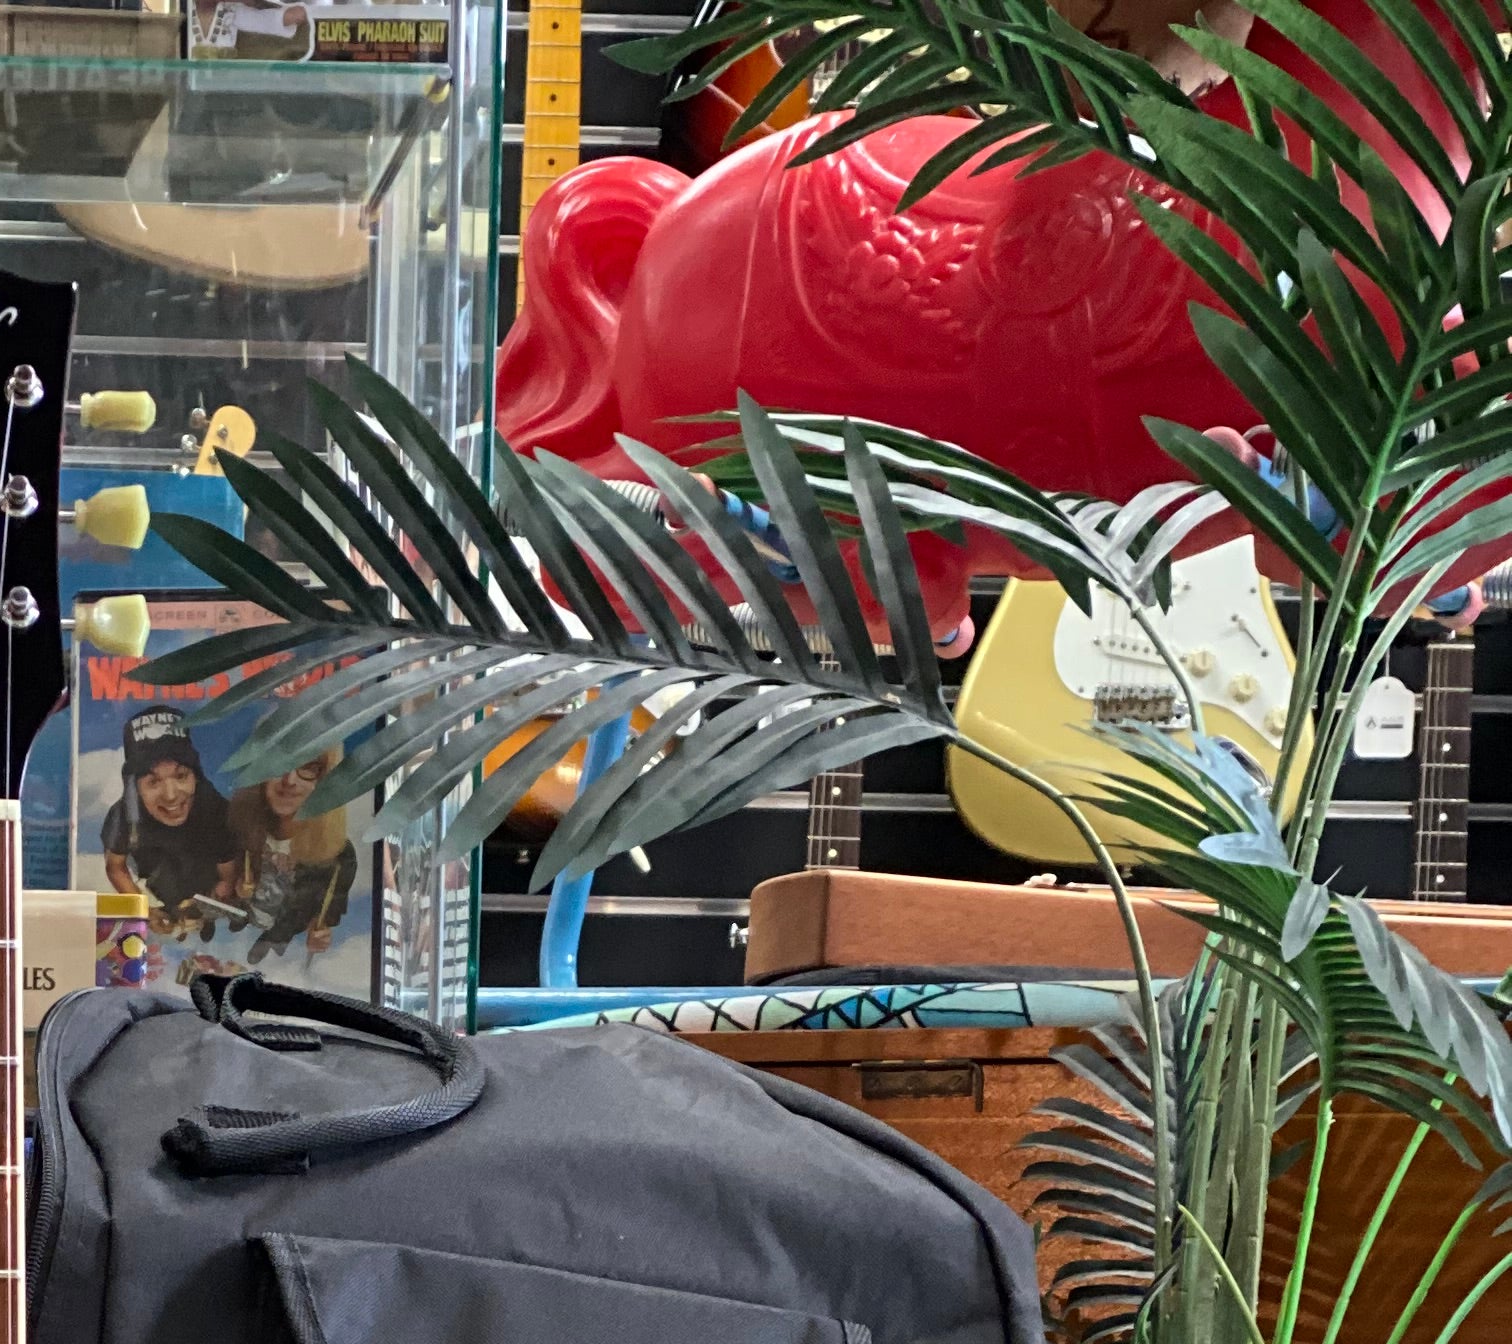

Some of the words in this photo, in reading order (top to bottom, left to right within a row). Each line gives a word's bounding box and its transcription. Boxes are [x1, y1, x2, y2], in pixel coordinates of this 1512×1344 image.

[317, 21, 351, 42] ELVIS
[357, 21, 416, 43] PHARAOH
[419, 22, 447, 43] SUIT
